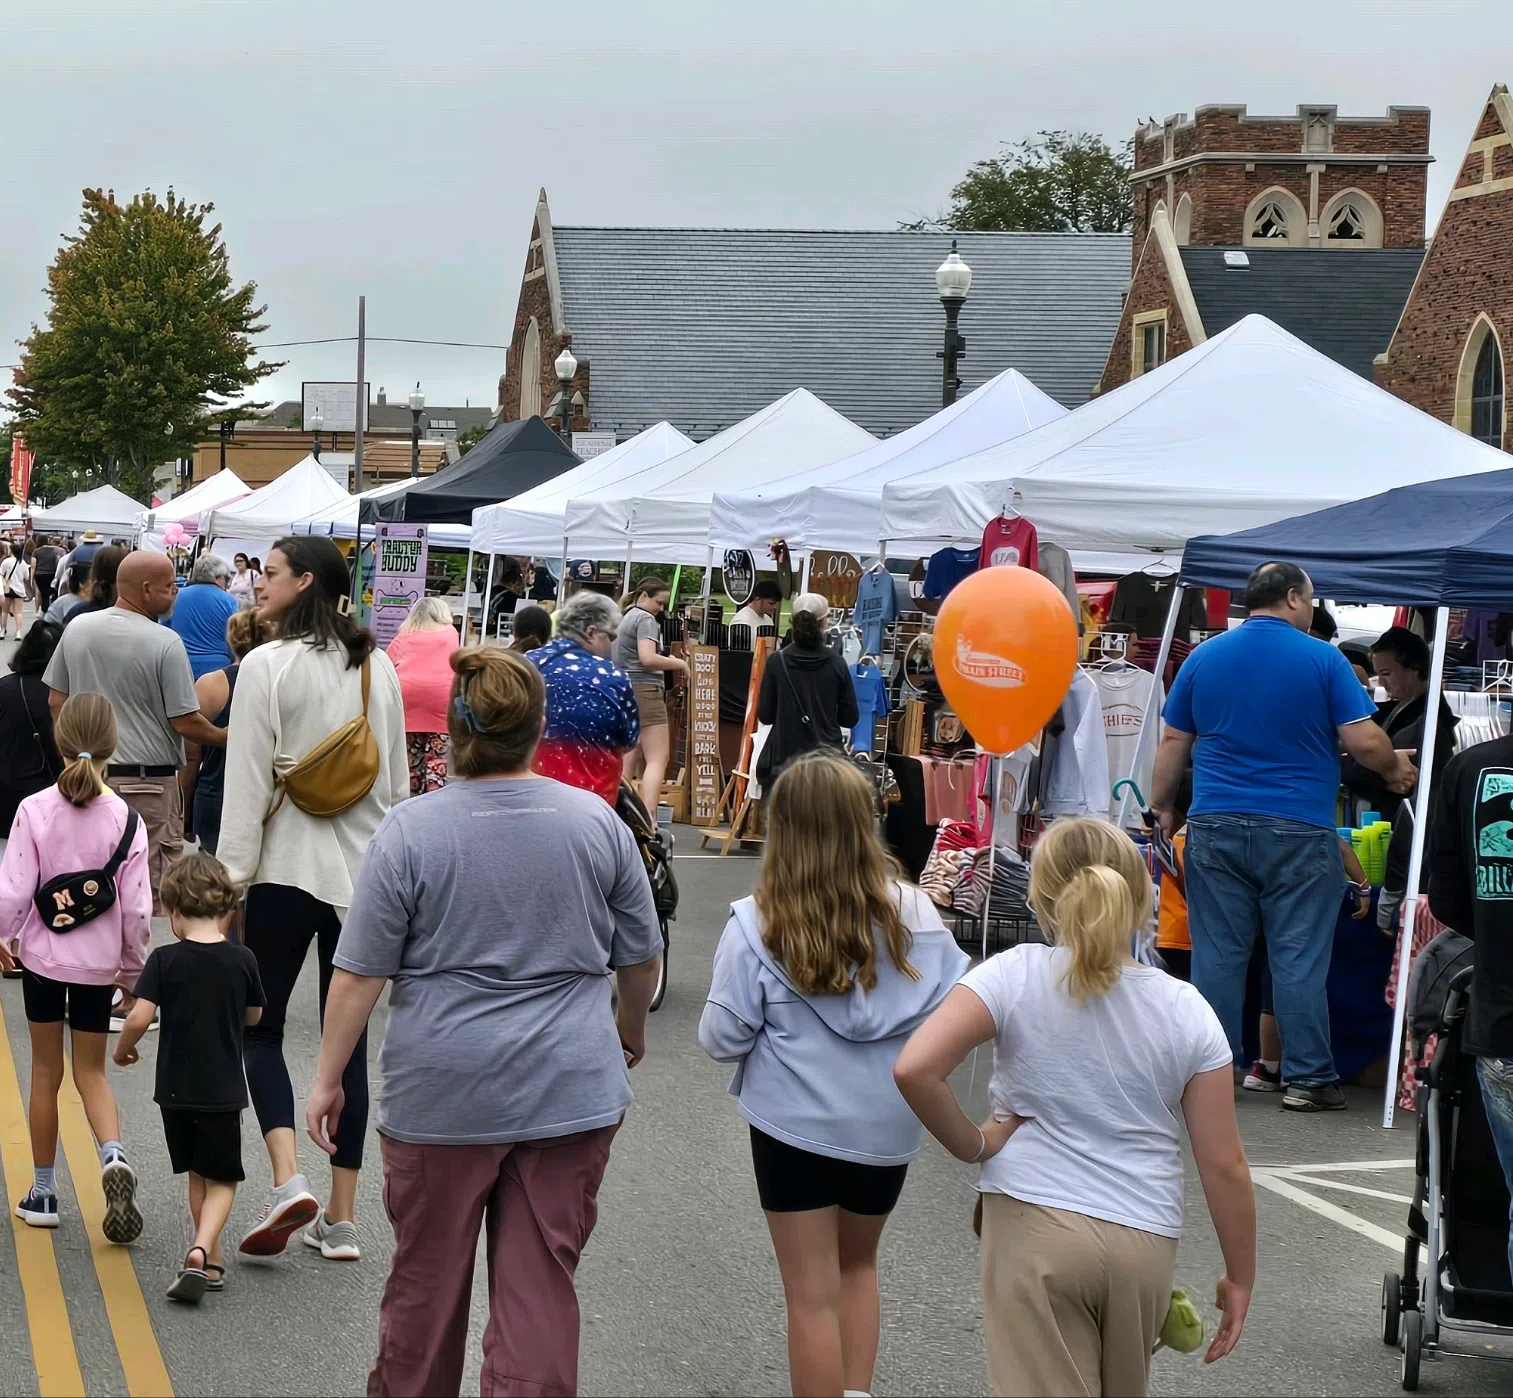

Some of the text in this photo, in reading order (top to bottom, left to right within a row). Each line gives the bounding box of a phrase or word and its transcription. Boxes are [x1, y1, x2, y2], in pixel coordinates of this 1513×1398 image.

[382, 540, 421, 555] TRACTOR
[382, 555, 418, 572] BUDDY
[695, 688, 715, 700] HERE
[696, 764, 716, 776] YELL
[1478, 865, 1513, 893] BILL
[52, 888, 75, 911] M
